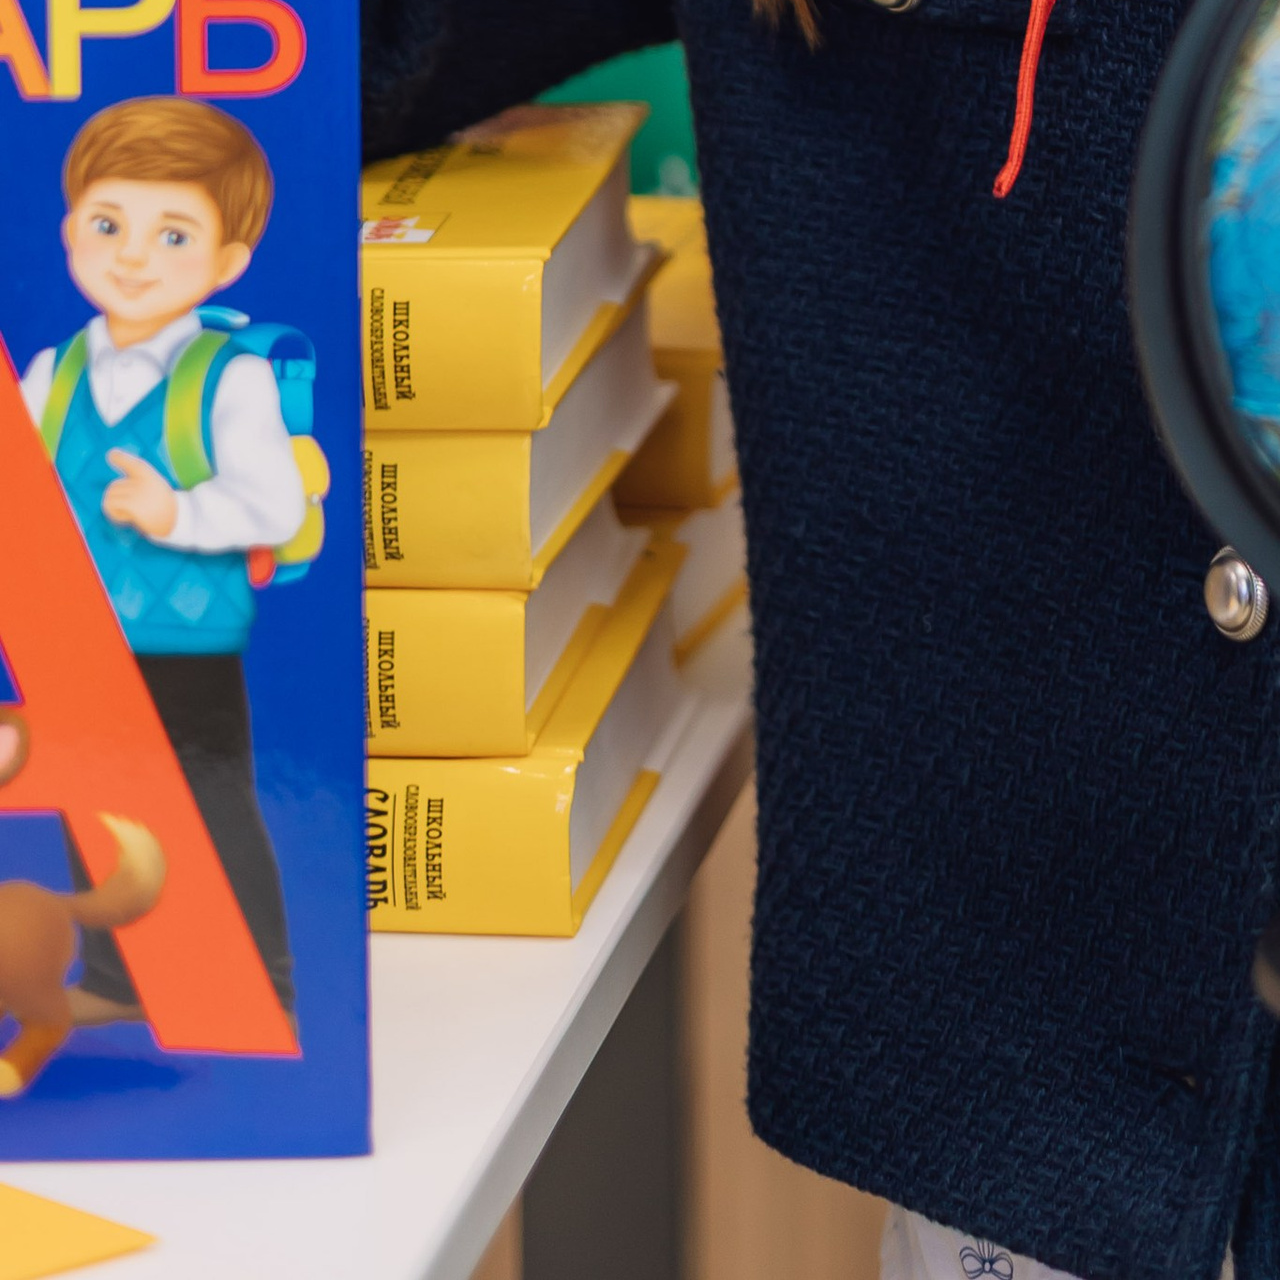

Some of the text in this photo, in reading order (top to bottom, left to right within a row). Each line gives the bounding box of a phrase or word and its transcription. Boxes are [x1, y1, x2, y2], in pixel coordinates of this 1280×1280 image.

[392, 300, 416, 400] ШКОЛЬНЫЙ
[380, 463, 404, 561] ШКОЛЬНЫЙ
[378, 630, 400, 729] ШКОЛЬНЫЙ
[426, 797, 446, 900] ШКОЛЬНЫЙ
